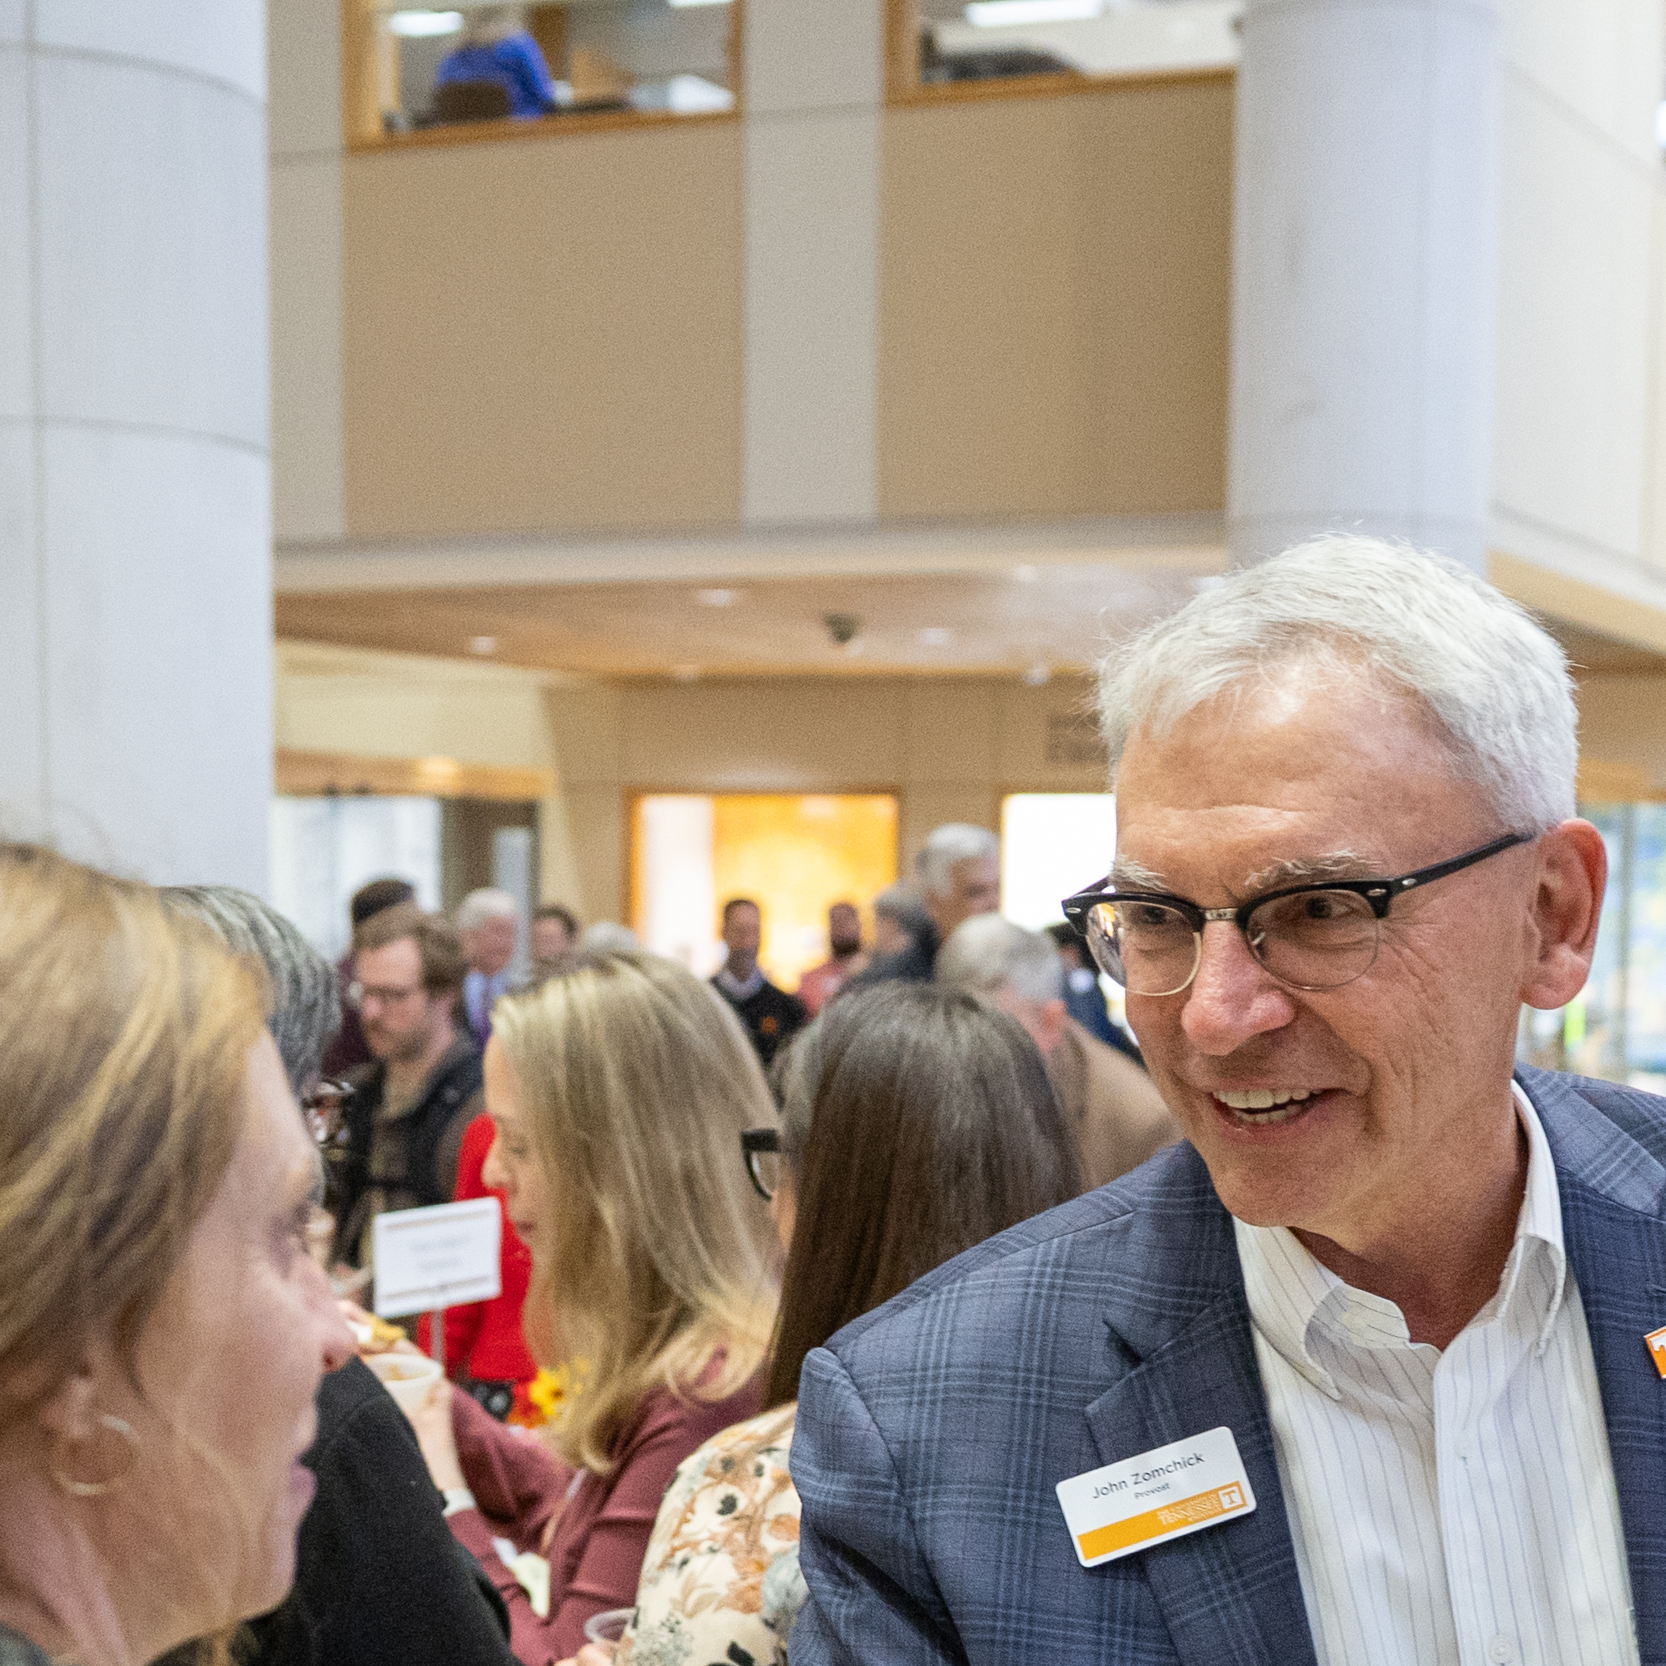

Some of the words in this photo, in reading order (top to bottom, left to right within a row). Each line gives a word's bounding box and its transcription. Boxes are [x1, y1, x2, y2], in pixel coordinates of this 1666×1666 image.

[1092, 1477, 1129, 1500] John
[1131, 1452, 1205, 1486] Zomchick
[1134, 1481, 1172, 1500] Provost
